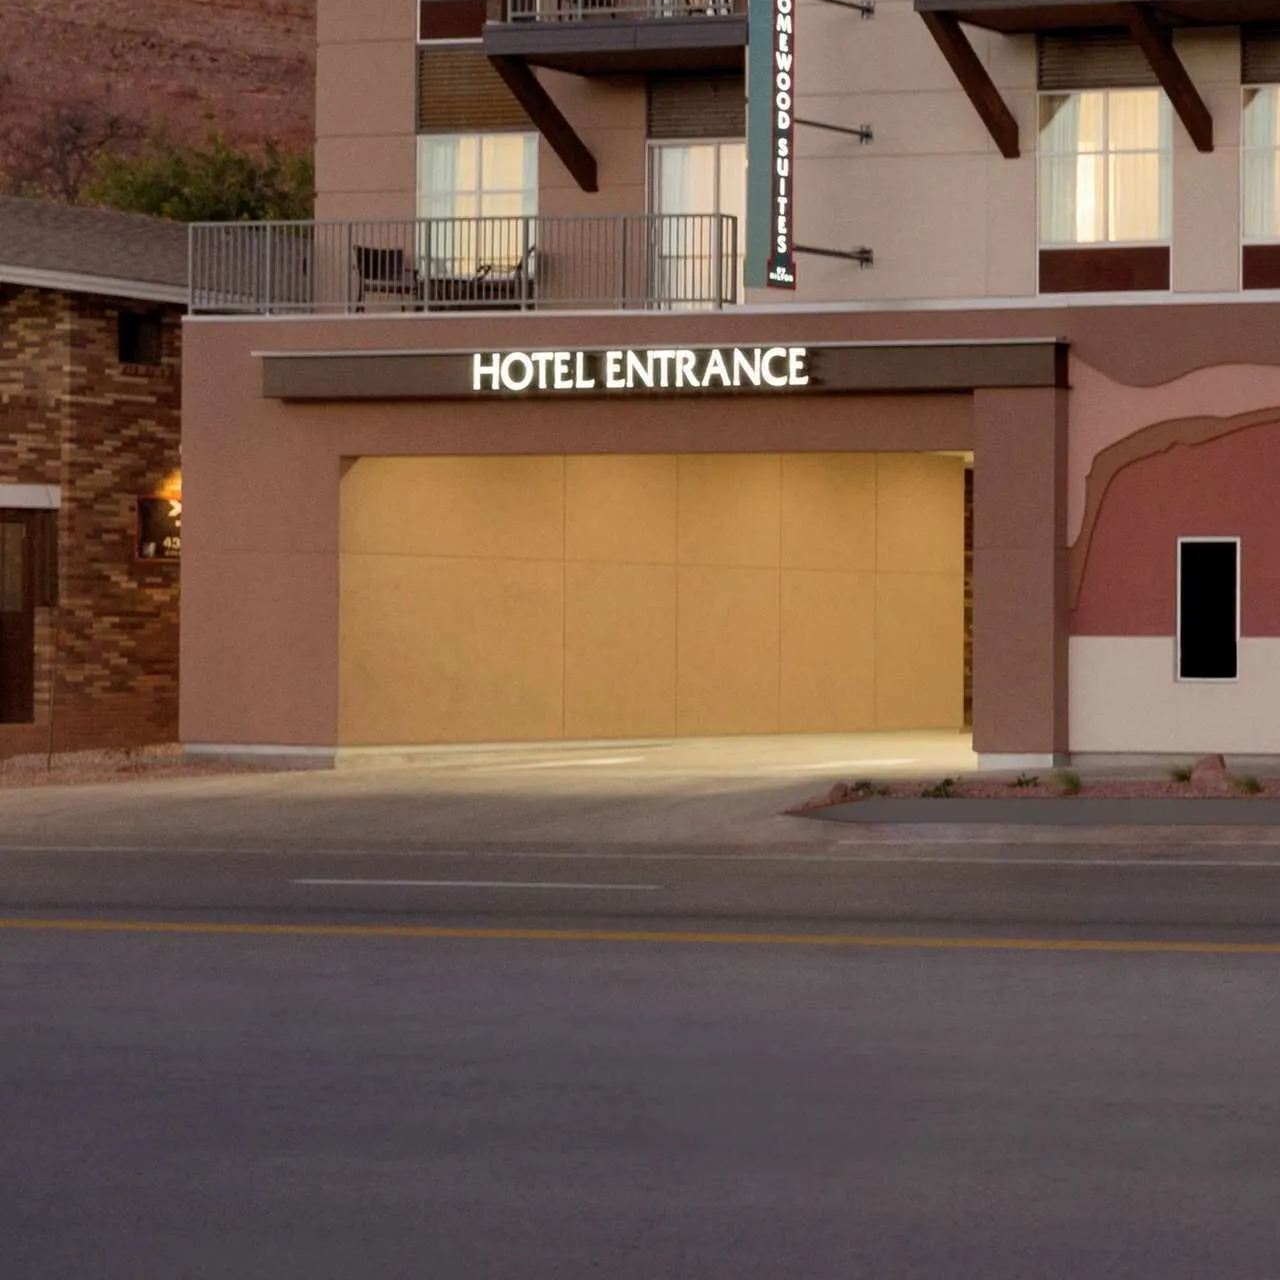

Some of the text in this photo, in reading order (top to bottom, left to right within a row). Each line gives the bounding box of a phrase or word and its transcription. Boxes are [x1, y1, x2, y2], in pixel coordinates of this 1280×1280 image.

[776, 137, 789, 254] SUITES
[473, 347, 809, 391] HOTEL ENTRANCE
